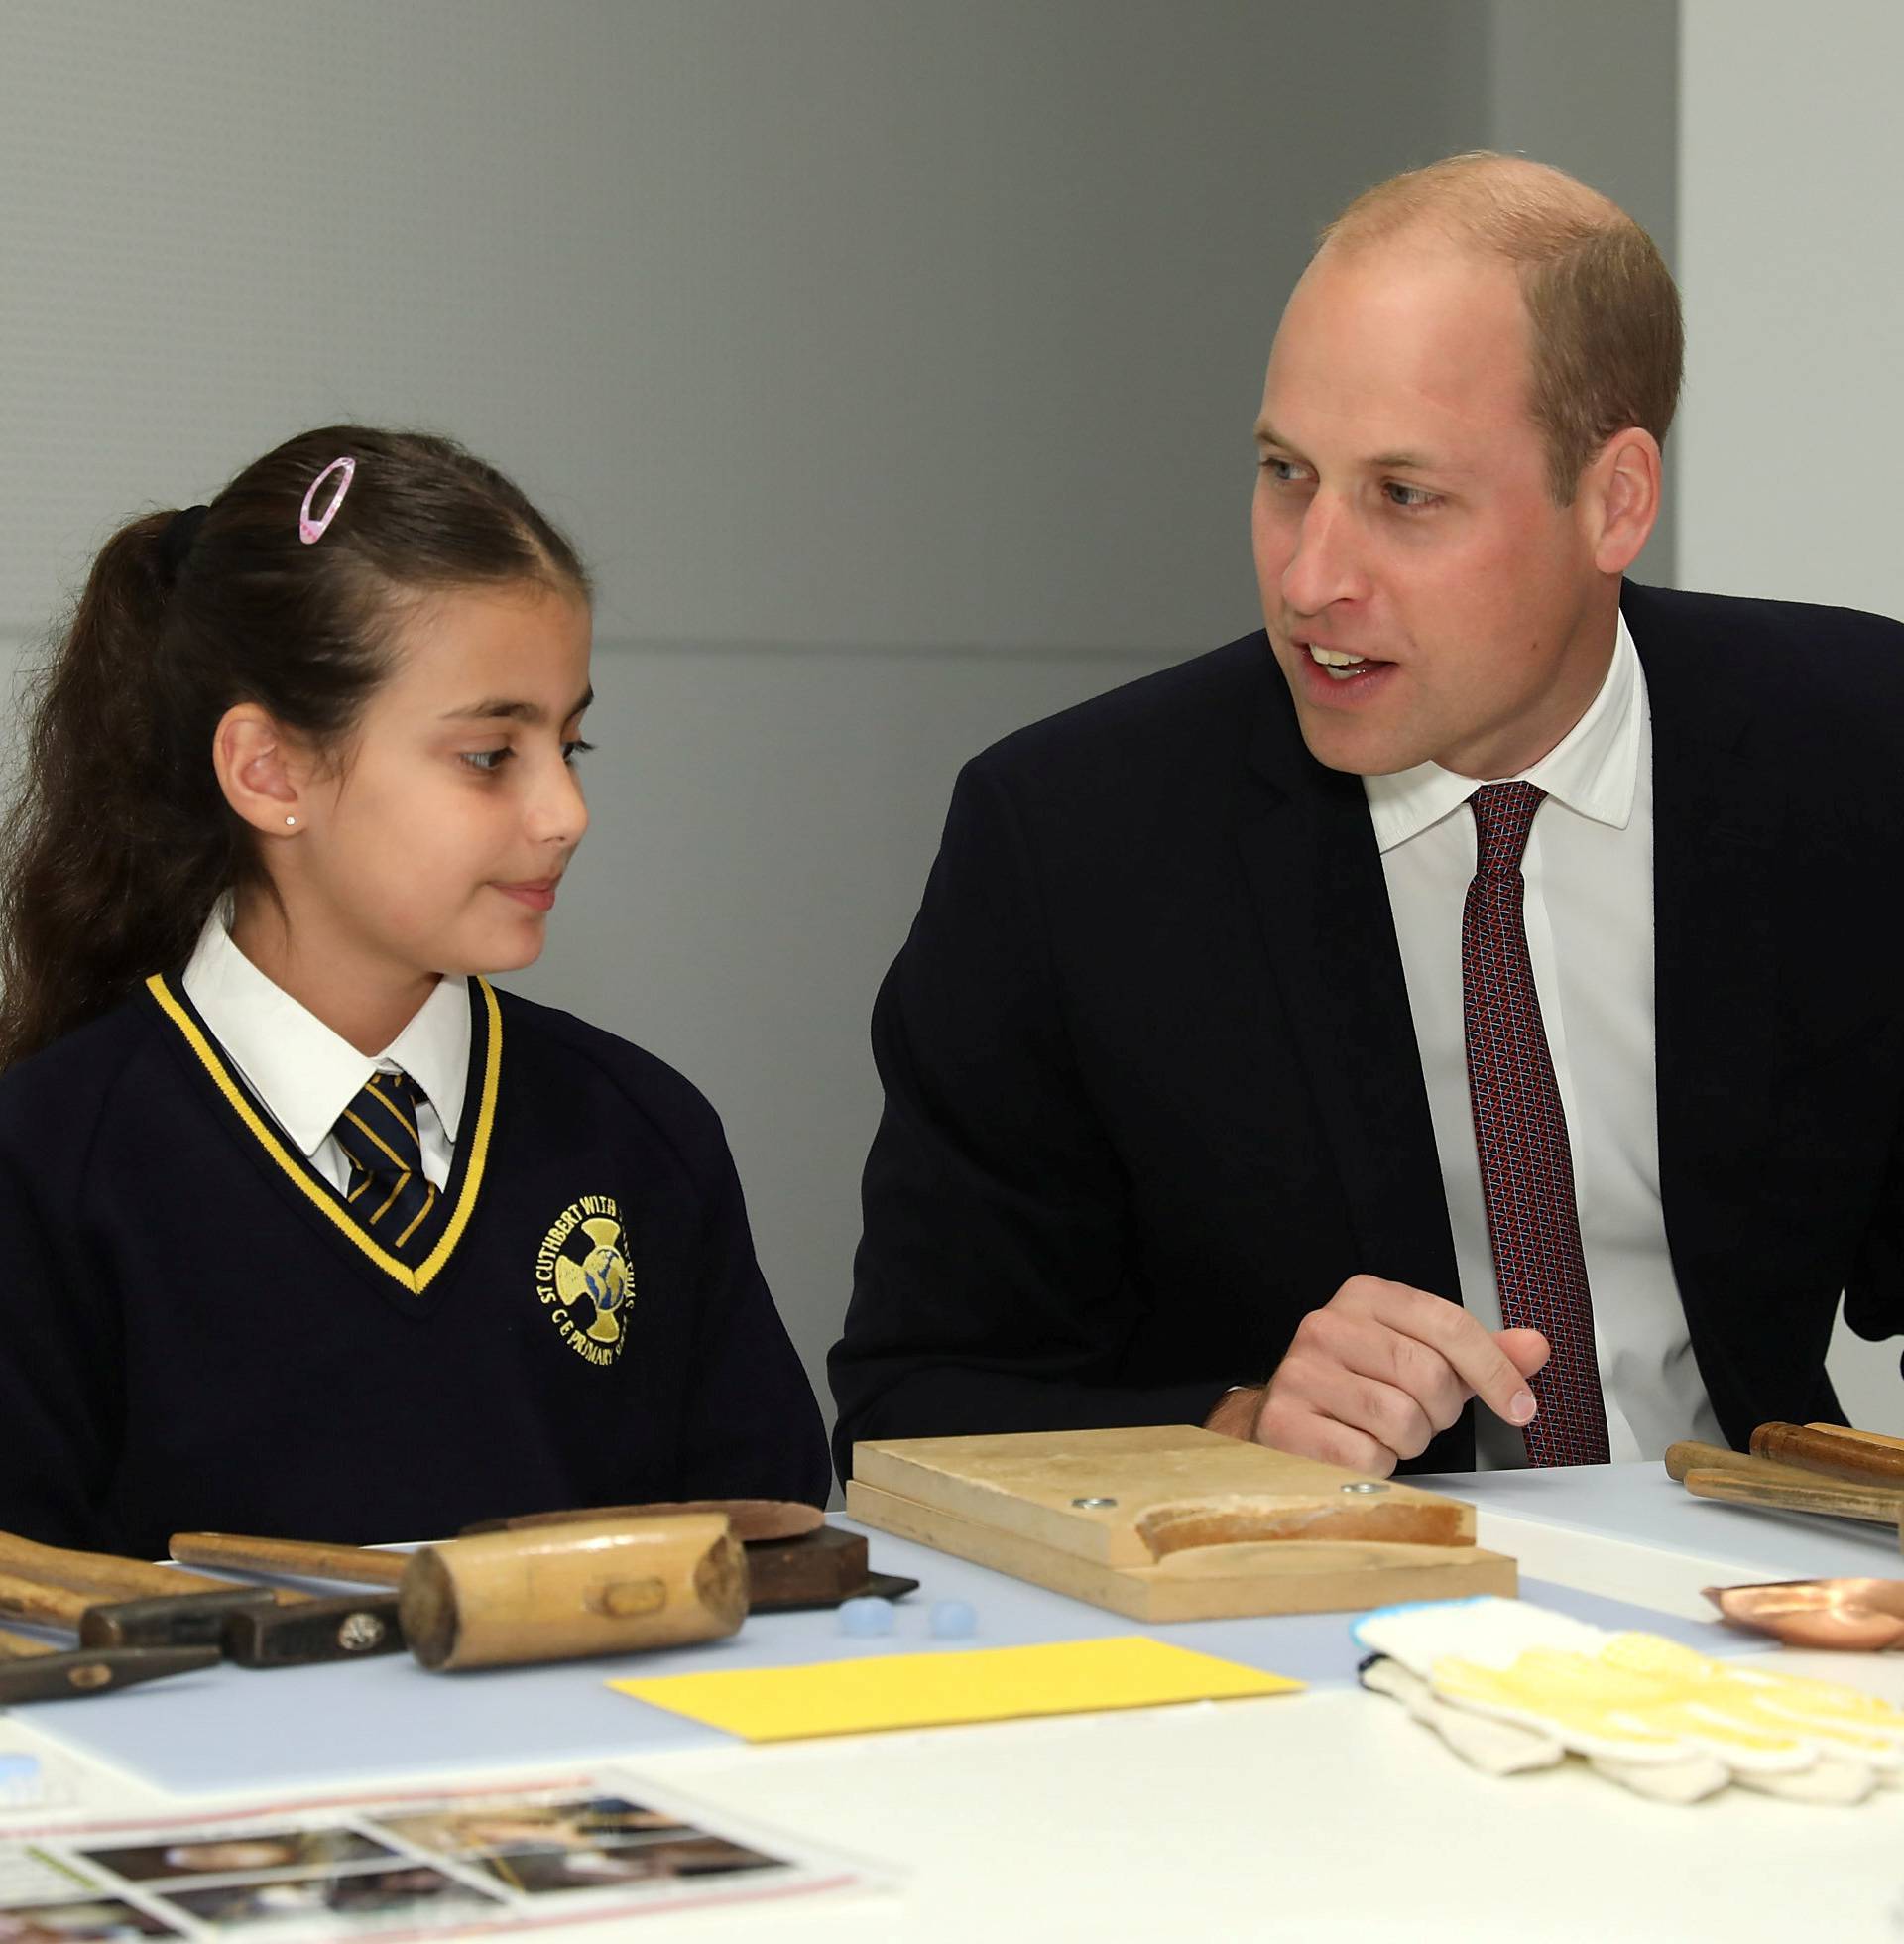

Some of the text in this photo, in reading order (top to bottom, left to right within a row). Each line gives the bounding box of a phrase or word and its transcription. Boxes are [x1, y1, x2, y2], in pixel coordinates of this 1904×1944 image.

[579, 1195, 616, 1216] WITH
[536, 1203, 583, 1281] CUTHBERT
[536, 1285, 556, 1304] ST
[566, 1329, 613, 1366] PRIMARY
